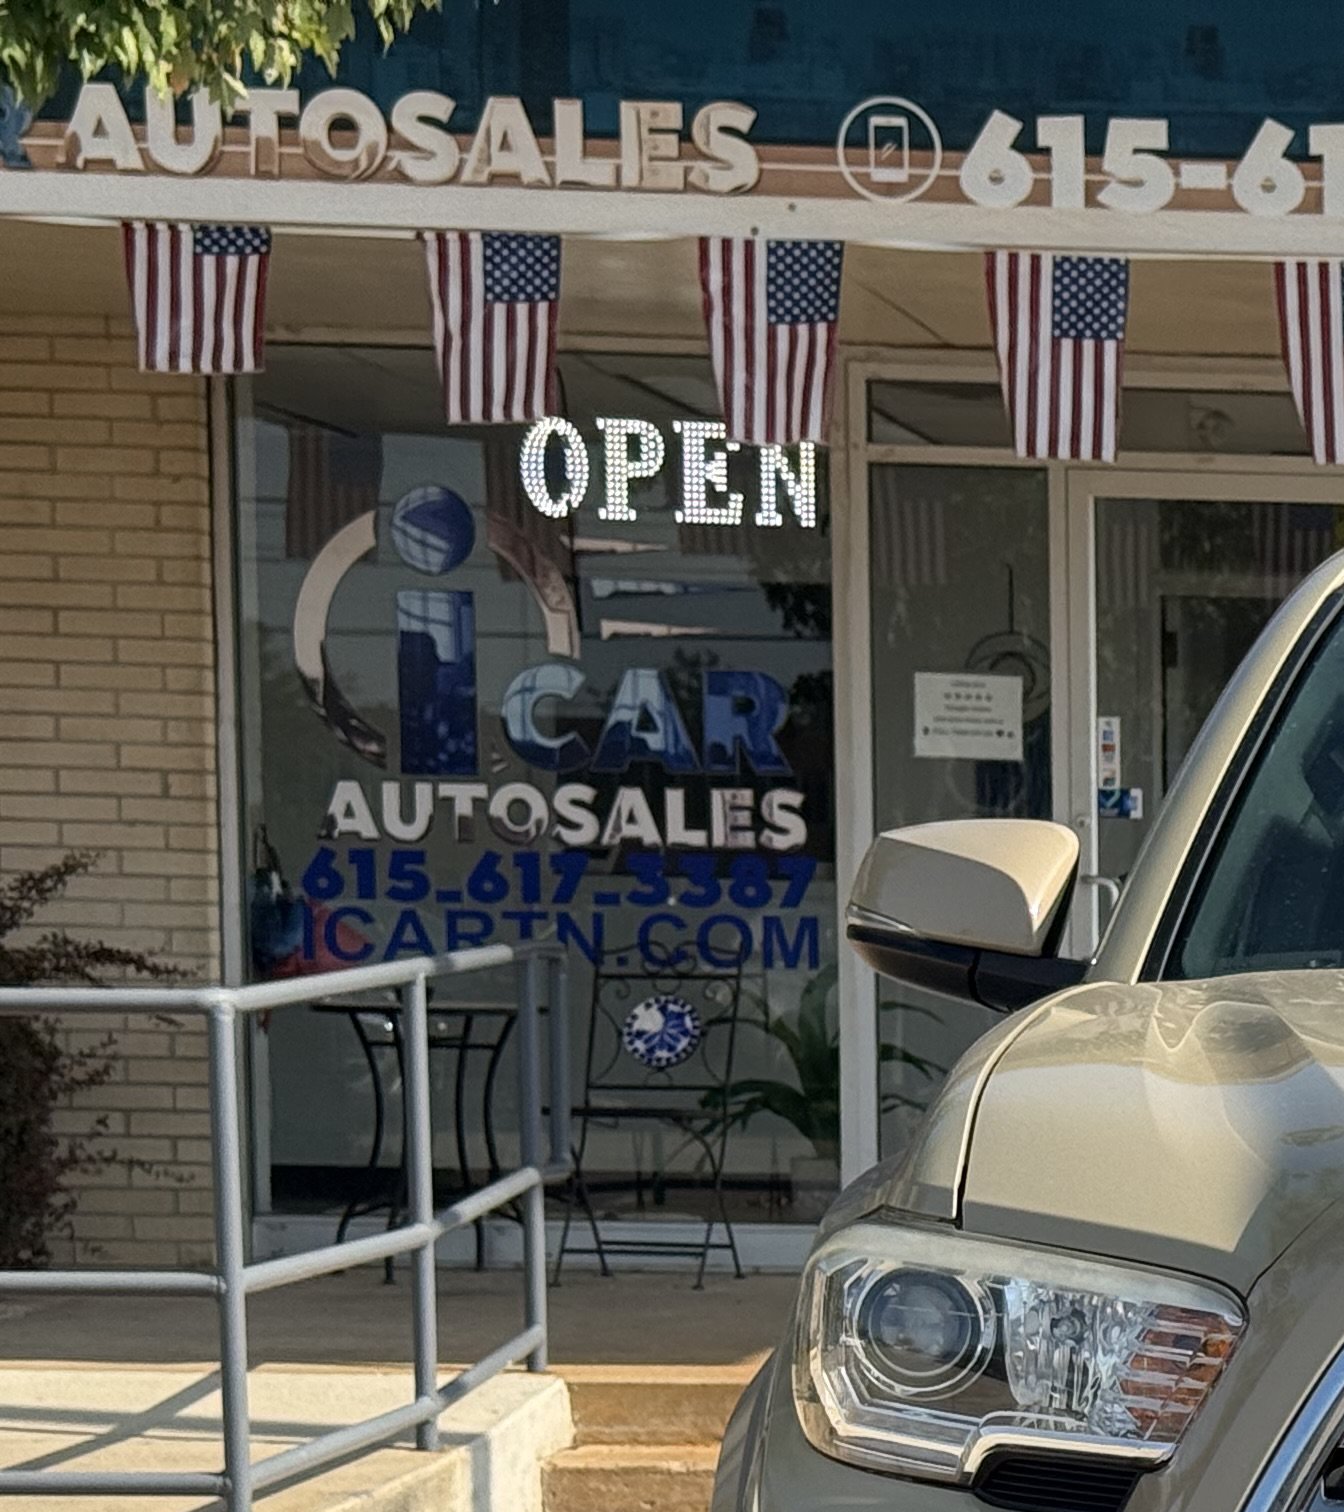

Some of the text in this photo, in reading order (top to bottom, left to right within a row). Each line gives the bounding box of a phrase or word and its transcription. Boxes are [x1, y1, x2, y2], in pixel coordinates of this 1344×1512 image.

[63, 82, 762, 194] AUTOSALES
[519, 415, 816, 528] OPEN
[317, 779, 809, 850] AUTOSALES
